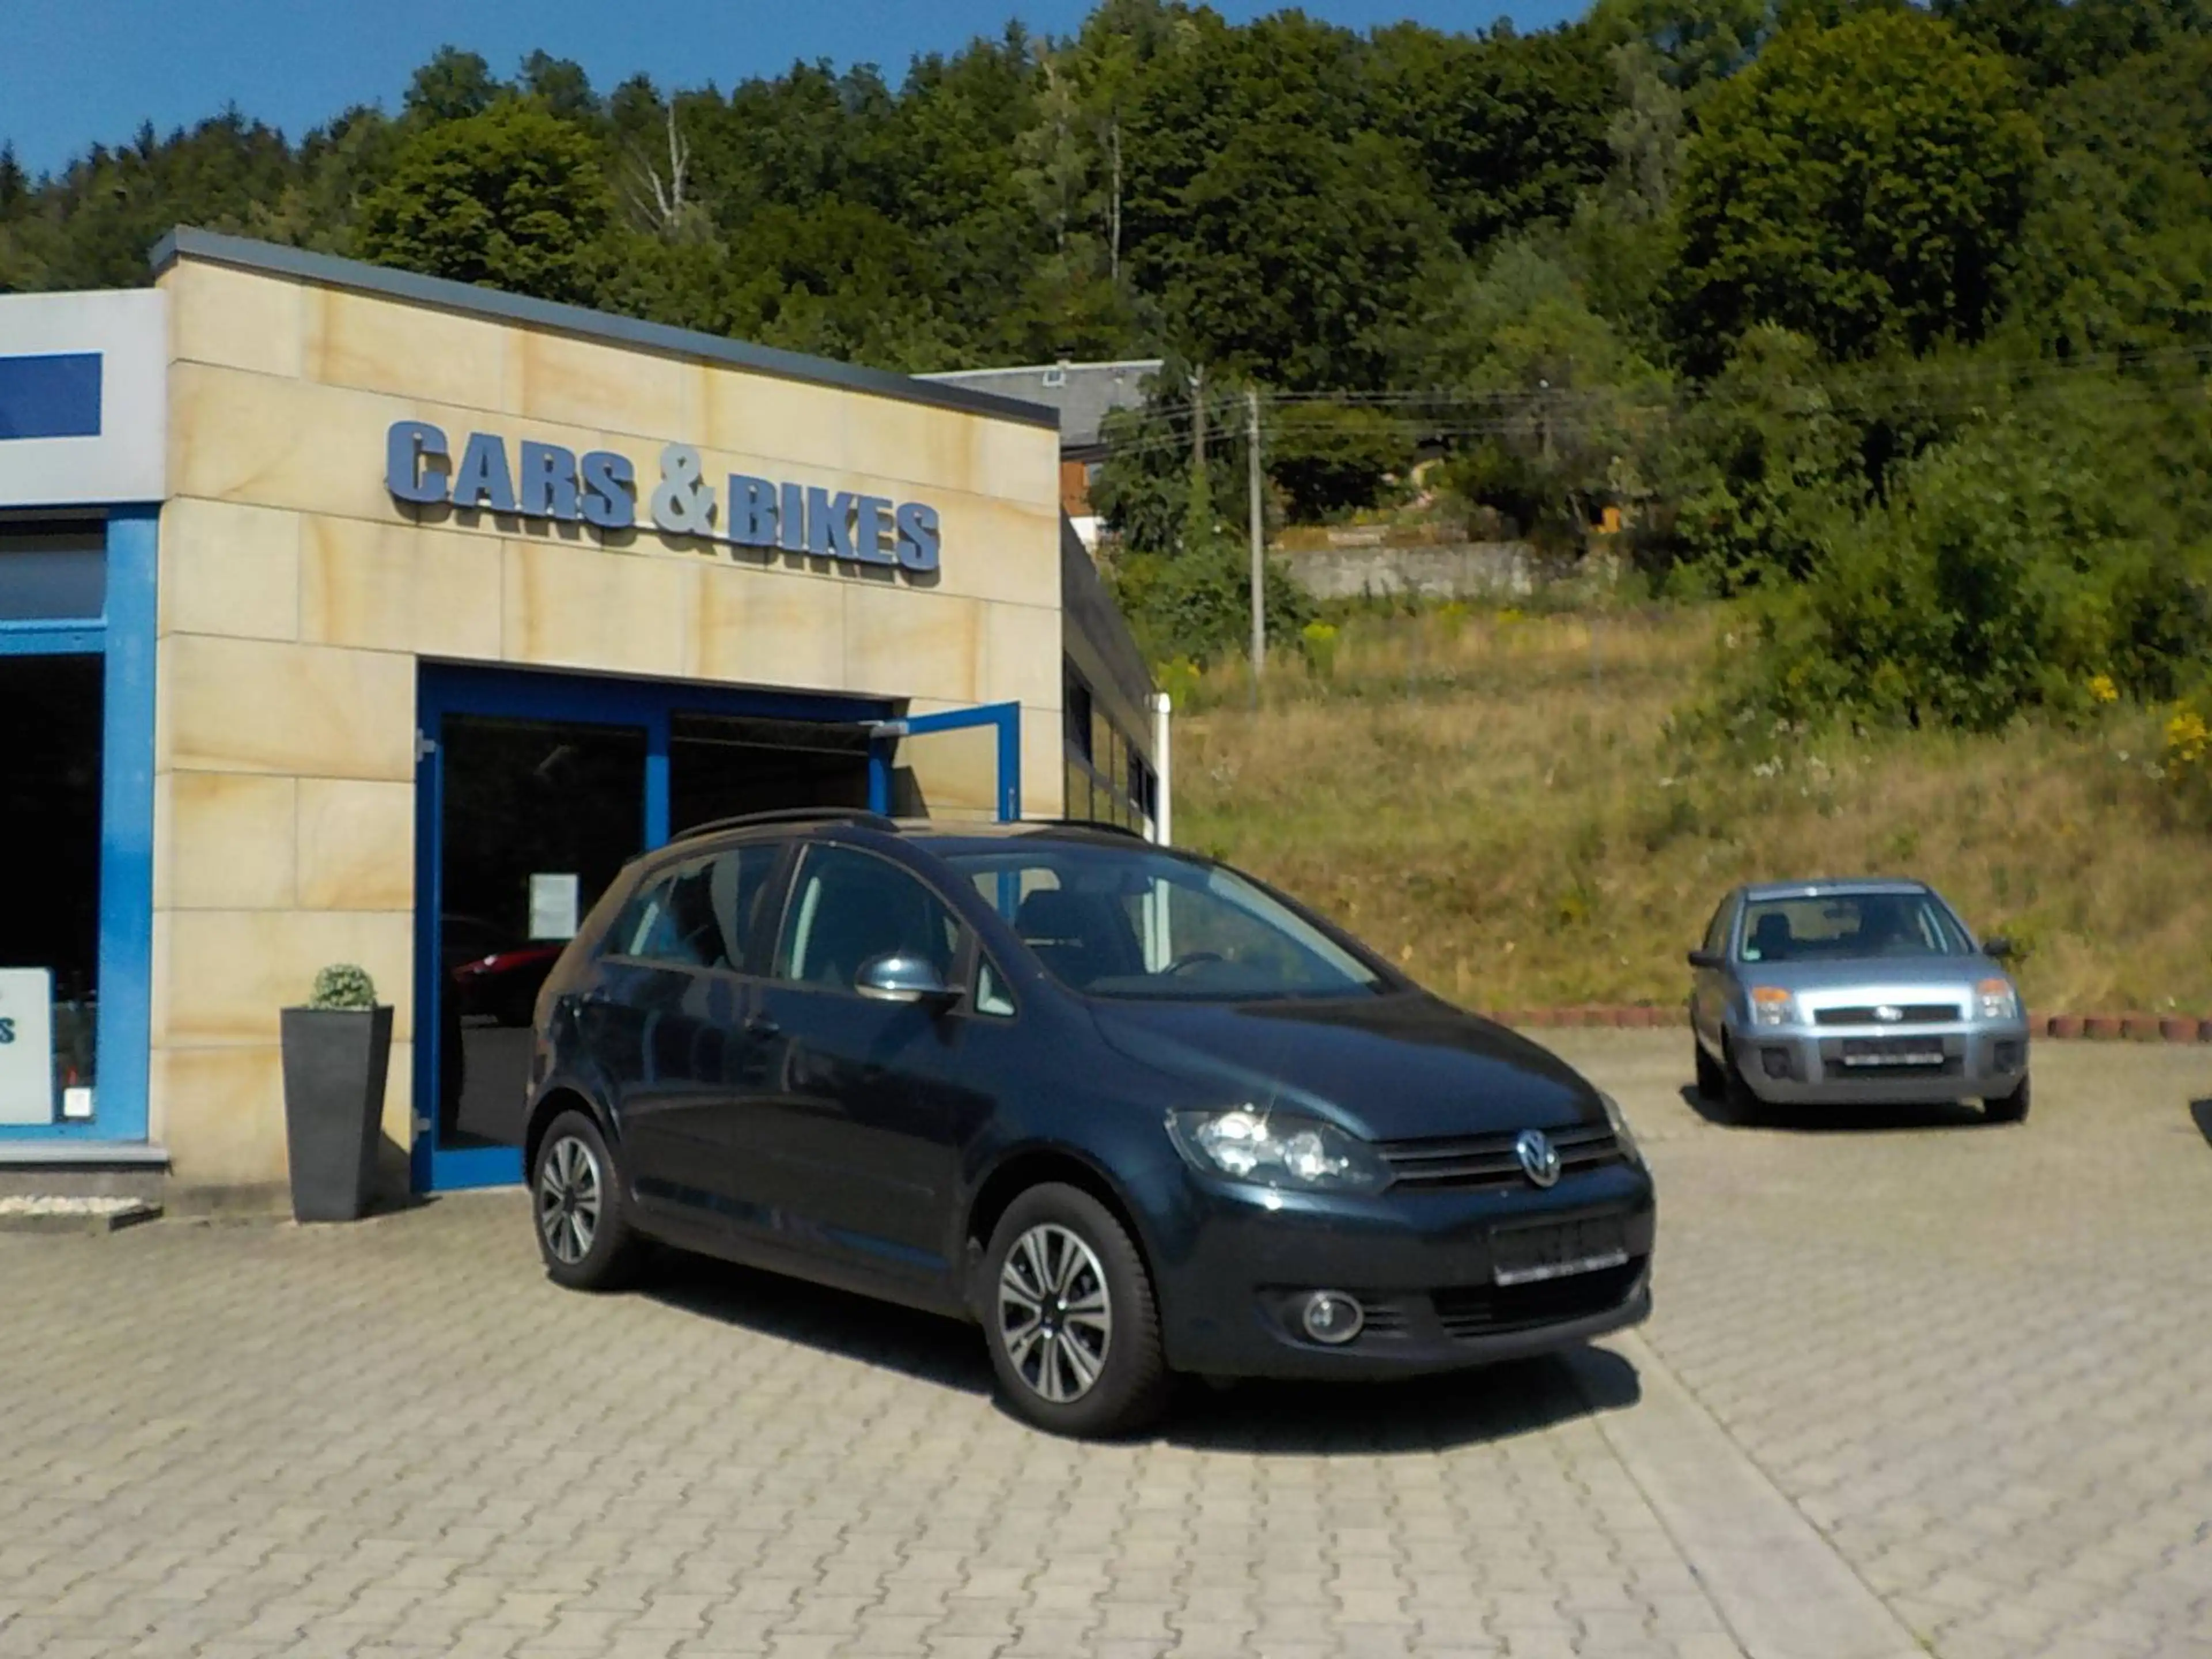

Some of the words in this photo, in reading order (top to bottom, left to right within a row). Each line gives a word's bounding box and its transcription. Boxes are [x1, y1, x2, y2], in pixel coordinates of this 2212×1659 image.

[387, 421, 635, 528] CARS
[651, 441, 716, 535] &
[729, 474, 940, 571] BIKES
